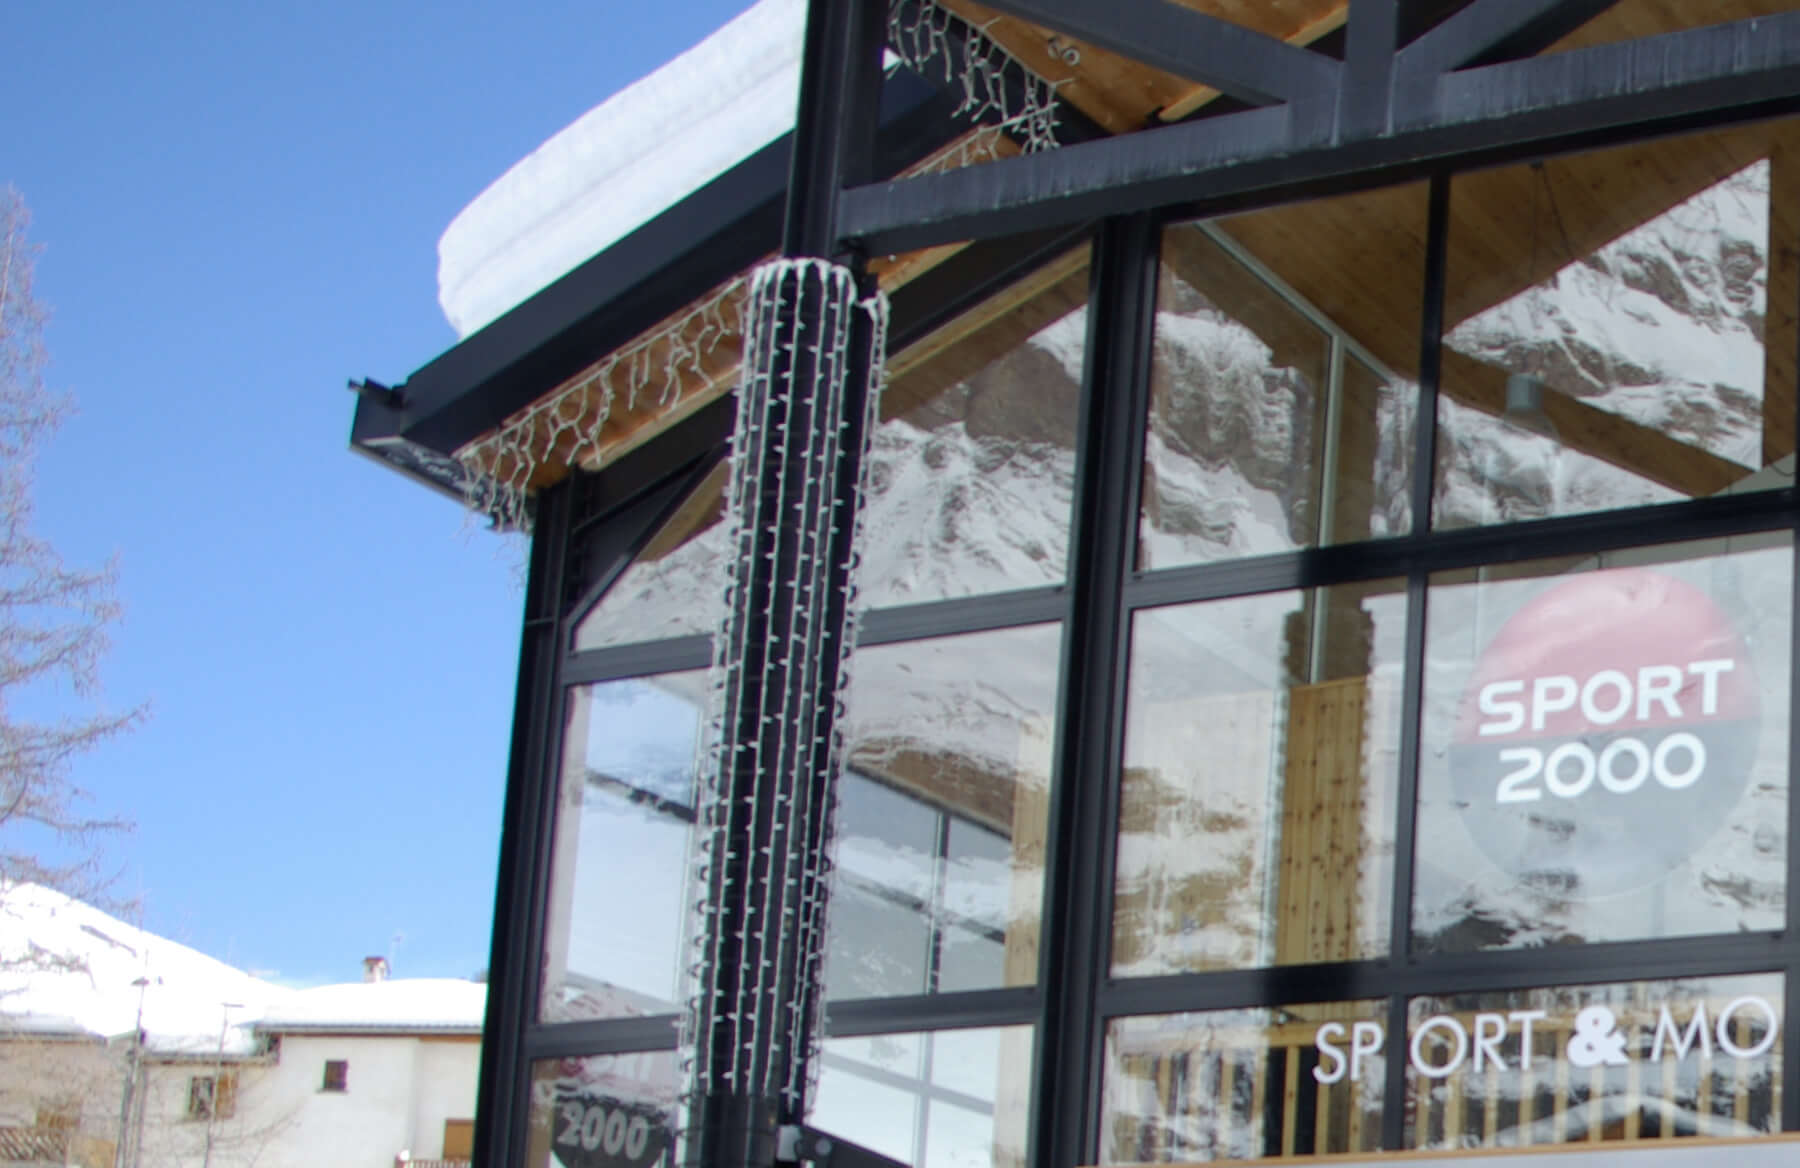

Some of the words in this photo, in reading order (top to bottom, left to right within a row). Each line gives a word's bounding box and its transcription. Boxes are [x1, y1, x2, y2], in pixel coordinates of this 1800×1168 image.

[1479, 658, 1735, 736] SPORT
[1496, 731, 1707, 803] 2000
[1567, 1005, 1630, 1068] &
[556, 1101, 649, 1161] 2000
